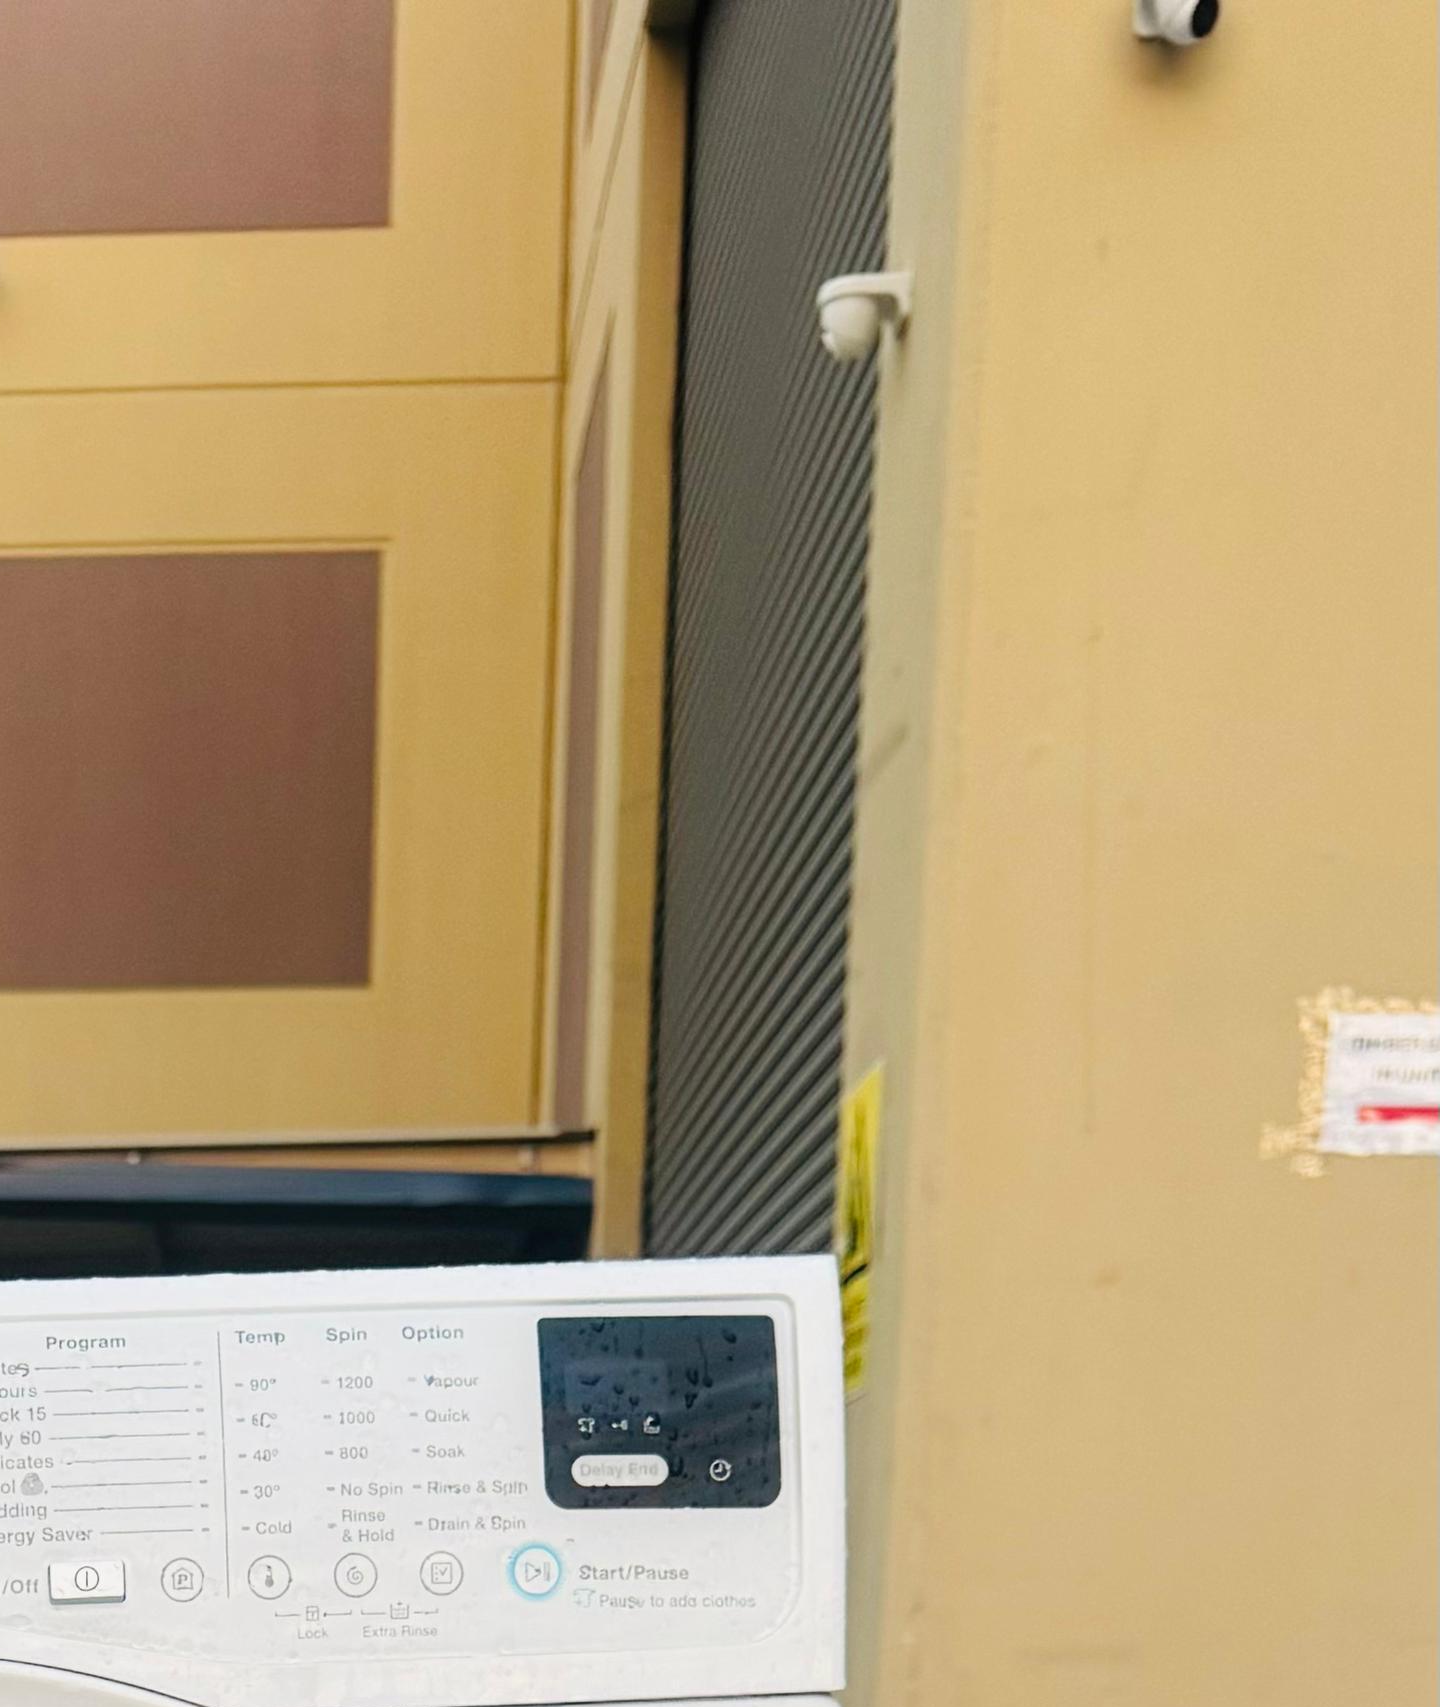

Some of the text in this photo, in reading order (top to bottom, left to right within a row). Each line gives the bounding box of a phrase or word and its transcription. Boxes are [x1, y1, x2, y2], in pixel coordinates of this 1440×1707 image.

[235, 1330, 285, 1345] Temp
[326, 1328, 367, 1343] Spin
[402, 1326, 464, 1342] Option
[46, 1335, 126, 1352] Program
[337, 1376, 373, 1389] 1200
[424, 1375, 479, 1388] Vapour
[27, 1407, 46, 1421] 15
[339, 1411, 375, 1425] 1000
[425, 1409, 470, 1423] Quick
[20, 1430, 41, 1445] 60
[339, 1447, 368, 1459] 800
[426, 1445, 465, 1459] Soak
[580, 1463, 659, 1479] Delay End
[340, 1482, 403, 1498] No Spin
[427, 1480, 471, 1495] Rinse
[341, 1509, 385, 1522] Rinse
[255, 1521, 292, 1535] Cold
[428, 1517, 470, 1531] Drain
[491, 1516, 526, 1532] Spin
[42, 1527, 93, 1542] Saver
[342, 1529, 395, 1542] & Hold
[578, 1565, 689, 1581] Start/Pause
[650, 1595, 664, 1607] to
[297, 1628, 328, 1639] Lock
[362, 1625, 438, 1638] Extra Rinse
